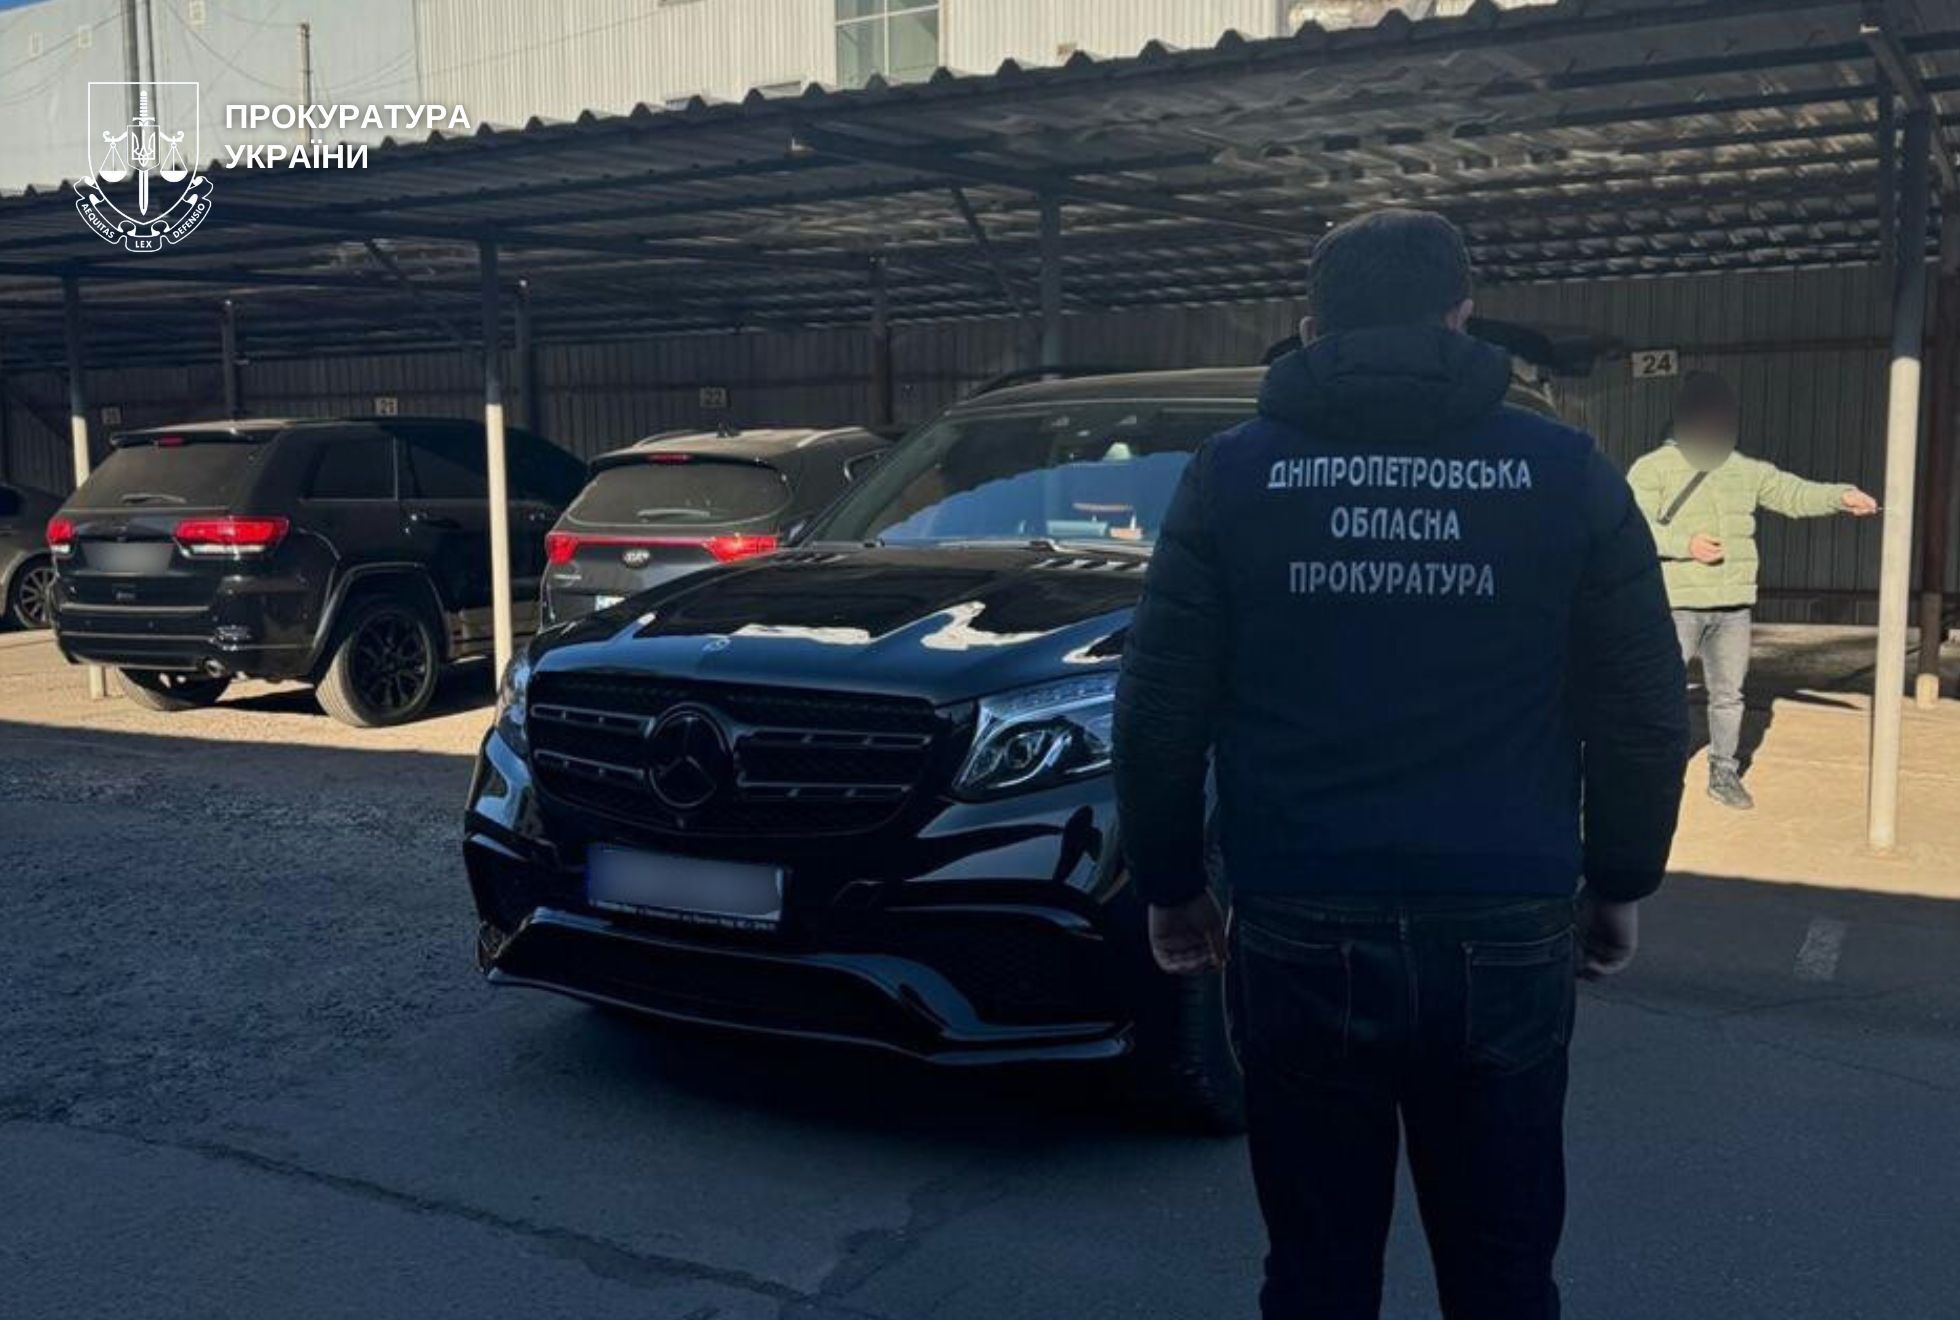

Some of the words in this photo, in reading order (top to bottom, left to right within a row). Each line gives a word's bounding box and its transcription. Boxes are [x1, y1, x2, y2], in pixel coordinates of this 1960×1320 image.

[1643, 353, 1671, 374] 24
[1267, 456, 1532, 490] ДНІПРОПЕТРОВСЬКА
[1330, 506, 1461, 540] ОБЛАСНА
[1289, 561, 1495, 596] ПРОКУРАТУРА
